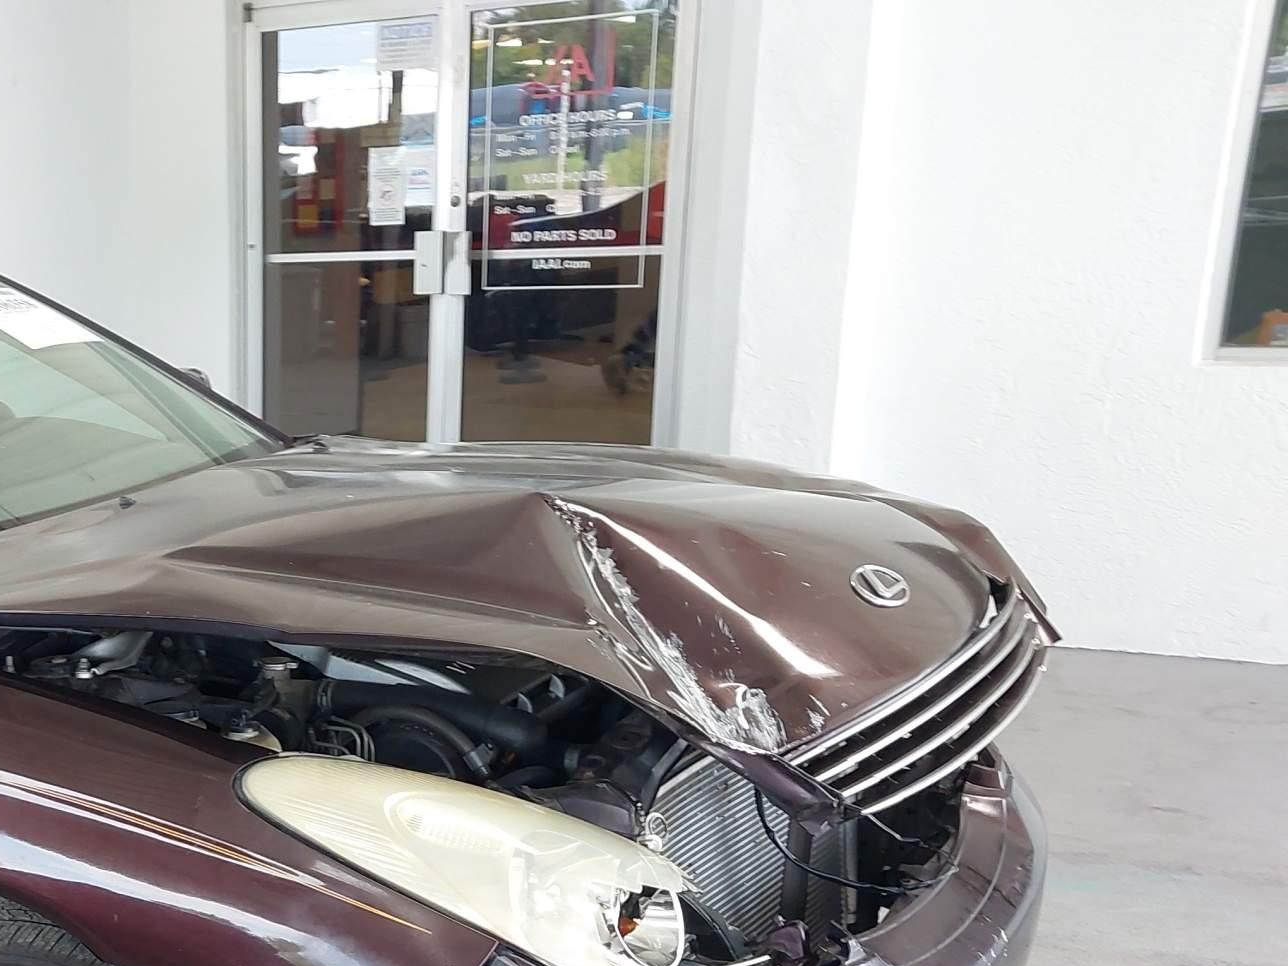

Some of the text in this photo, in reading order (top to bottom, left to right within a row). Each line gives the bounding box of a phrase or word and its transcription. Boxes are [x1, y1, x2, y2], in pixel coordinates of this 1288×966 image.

[519, 109, 617, 127] OFFICE HOURS
[511, 228, 617, 242] NO PARTS SOLD
[532, 258, 592, 270] IAAI.com
